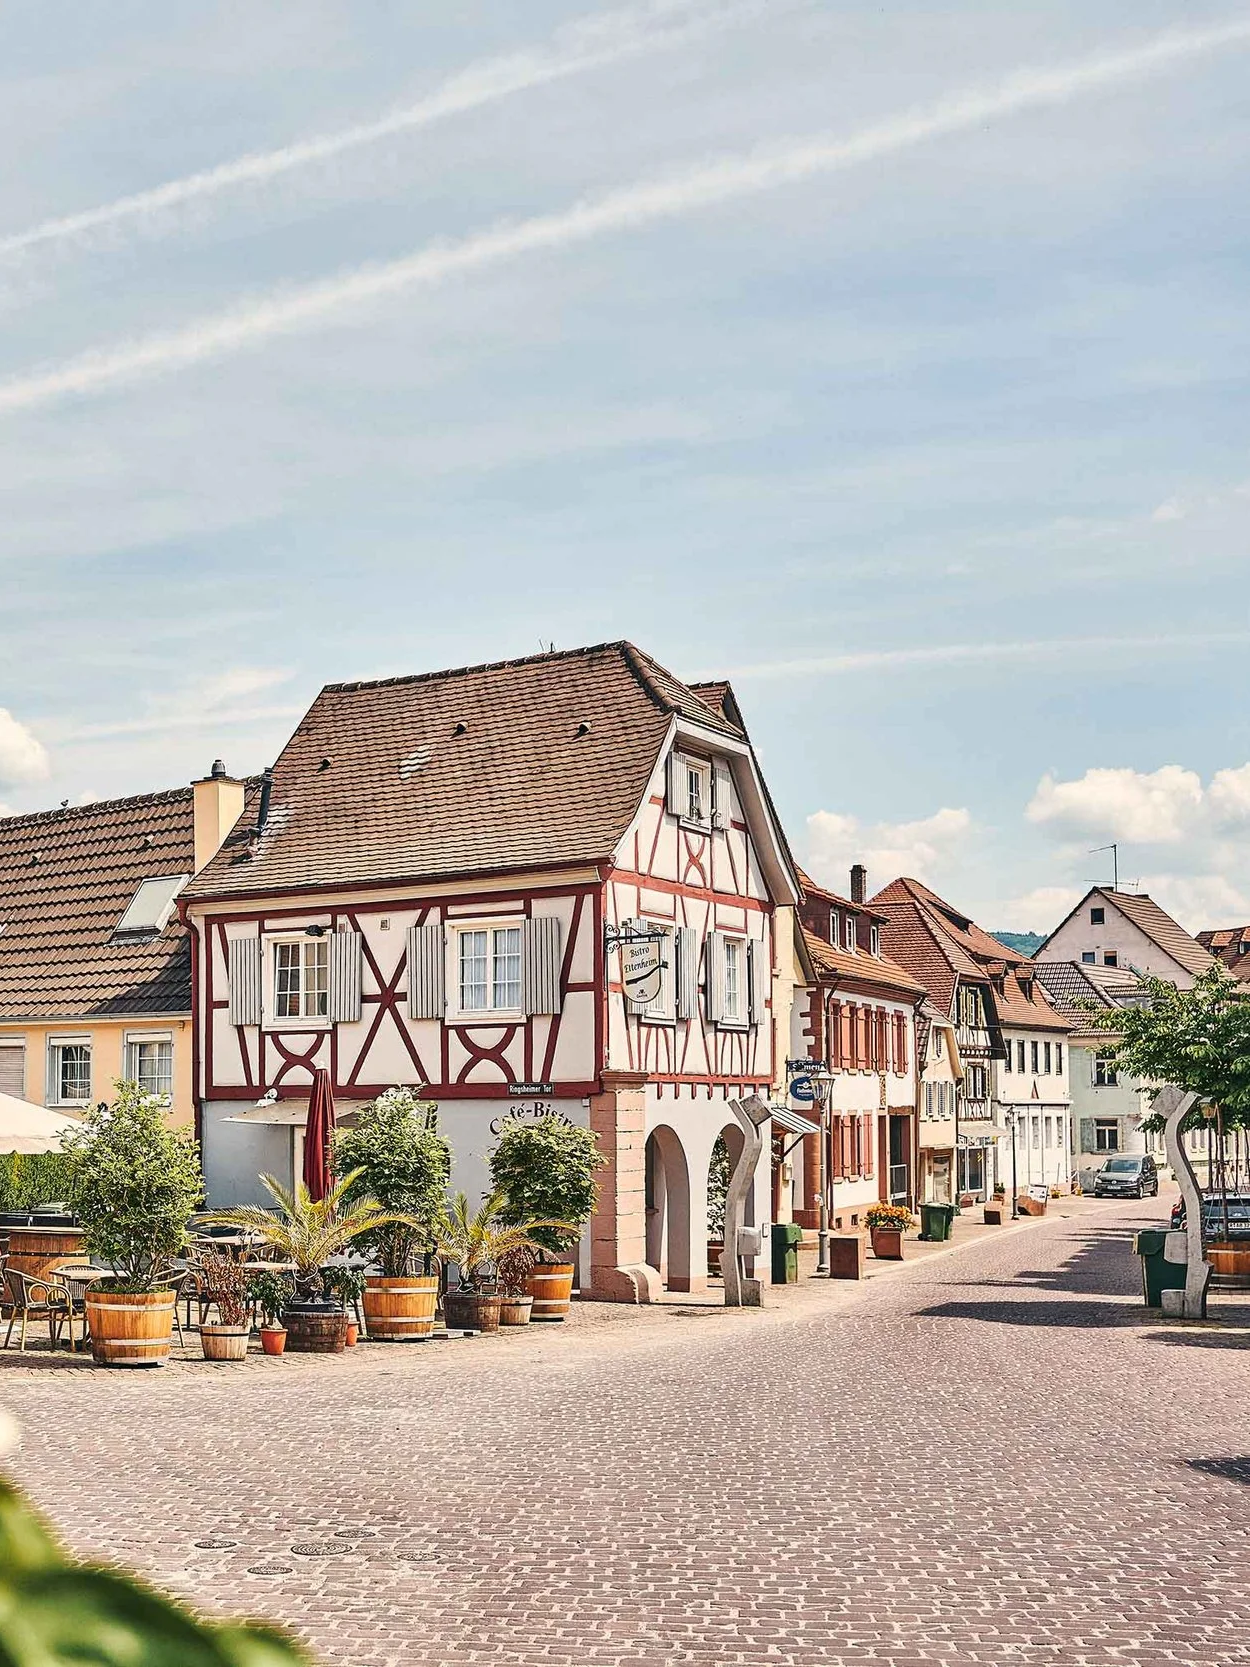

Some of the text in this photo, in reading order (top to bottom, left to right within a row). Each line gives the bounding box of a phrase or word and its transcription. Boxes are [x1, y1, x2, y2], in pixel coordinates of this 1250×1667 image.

[629, 946, 650, 958] Bistro
[510, 1084, 552, 1094] Ringsheimer Tor
